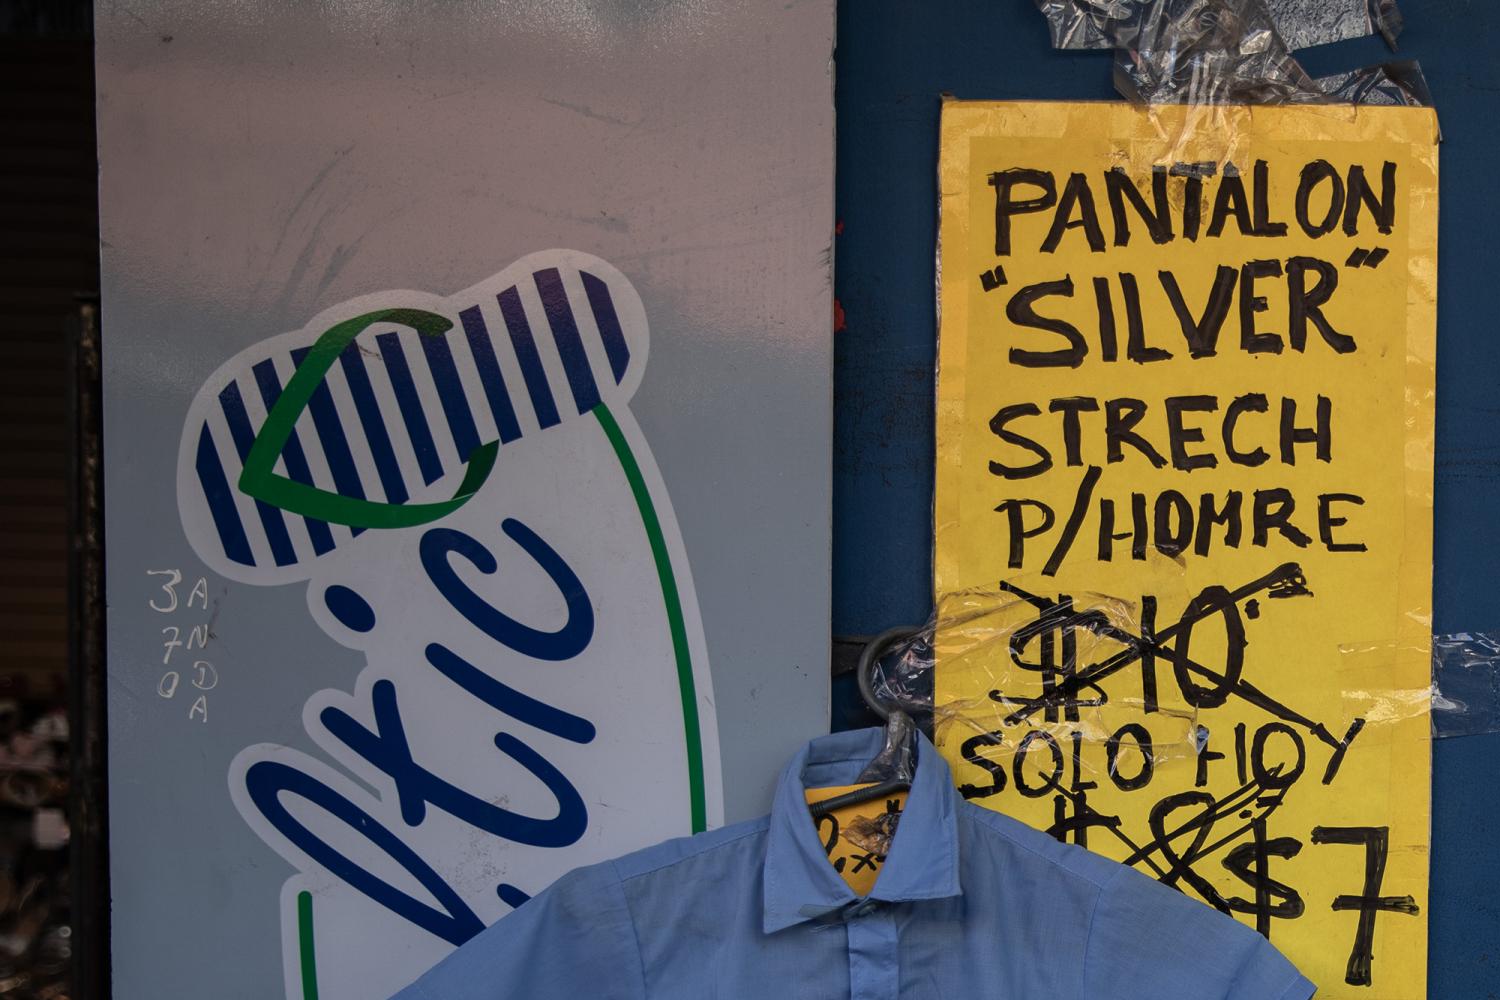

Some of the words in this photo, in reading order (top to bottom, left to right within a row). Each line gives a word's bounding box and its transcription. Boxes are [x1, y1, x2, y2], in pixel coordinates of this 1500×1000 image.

[987, 158, 1397, 256] PANTALON
[988, 392, 1333, 480] STRECH
[958, 722, 1155, 799] SOLO
[1195, 717, 1366, 788] HOY
